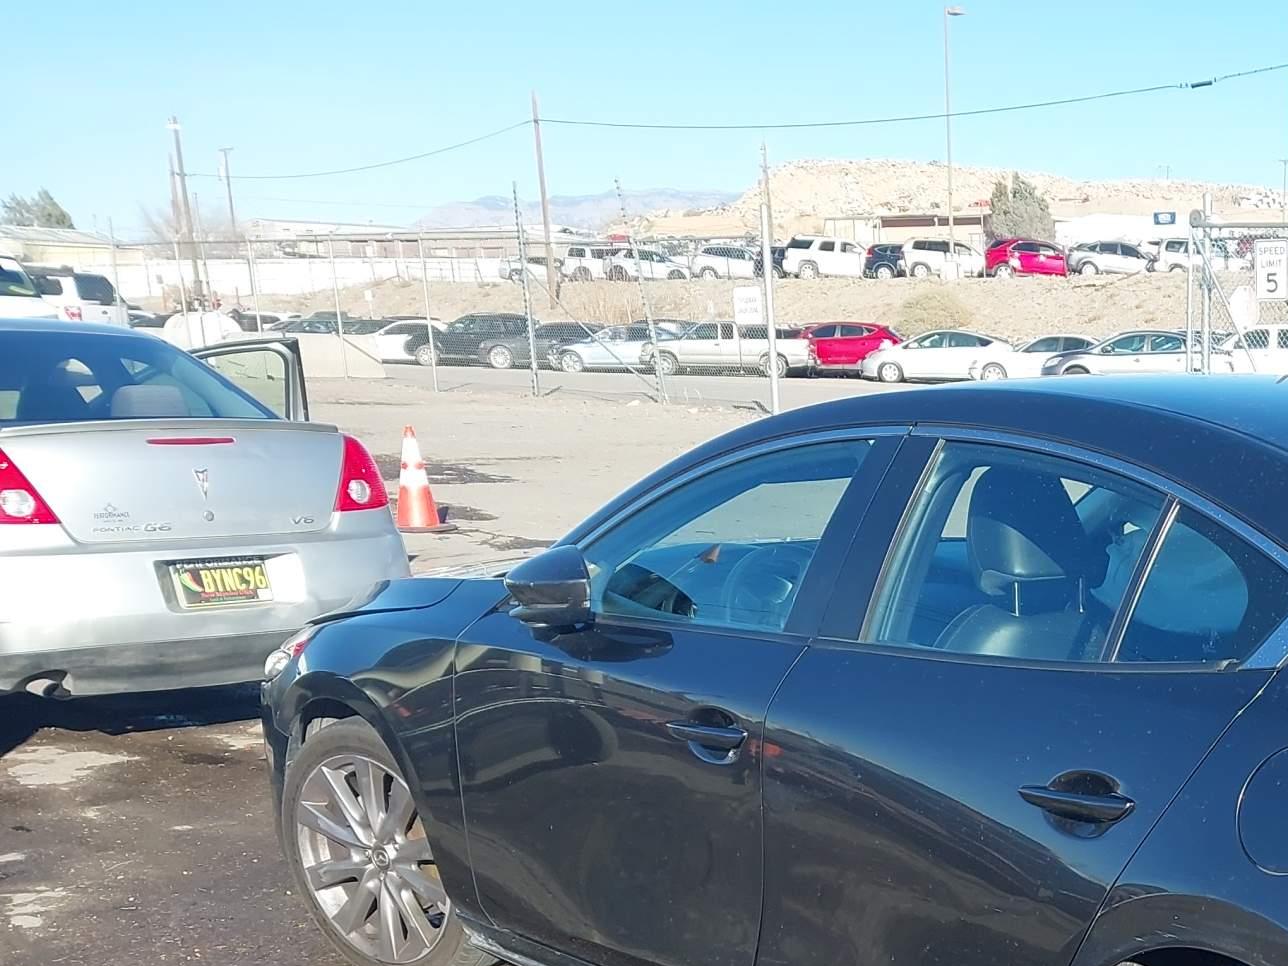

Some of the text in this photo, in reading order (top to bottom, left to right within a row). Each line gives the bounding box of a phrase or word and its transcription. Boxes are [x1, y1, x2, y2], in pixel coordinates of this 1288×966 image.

[1258, 246, 1285, 255] SPEED
[1260, 258, 1282, 268] LIMIT
[1266, 272, 1278, 293] 5
[291, 515, 315, 525] V6
[92, 521, 173, 533] PONTIAC G6
[200, 566, 267, 592] BYNC96
